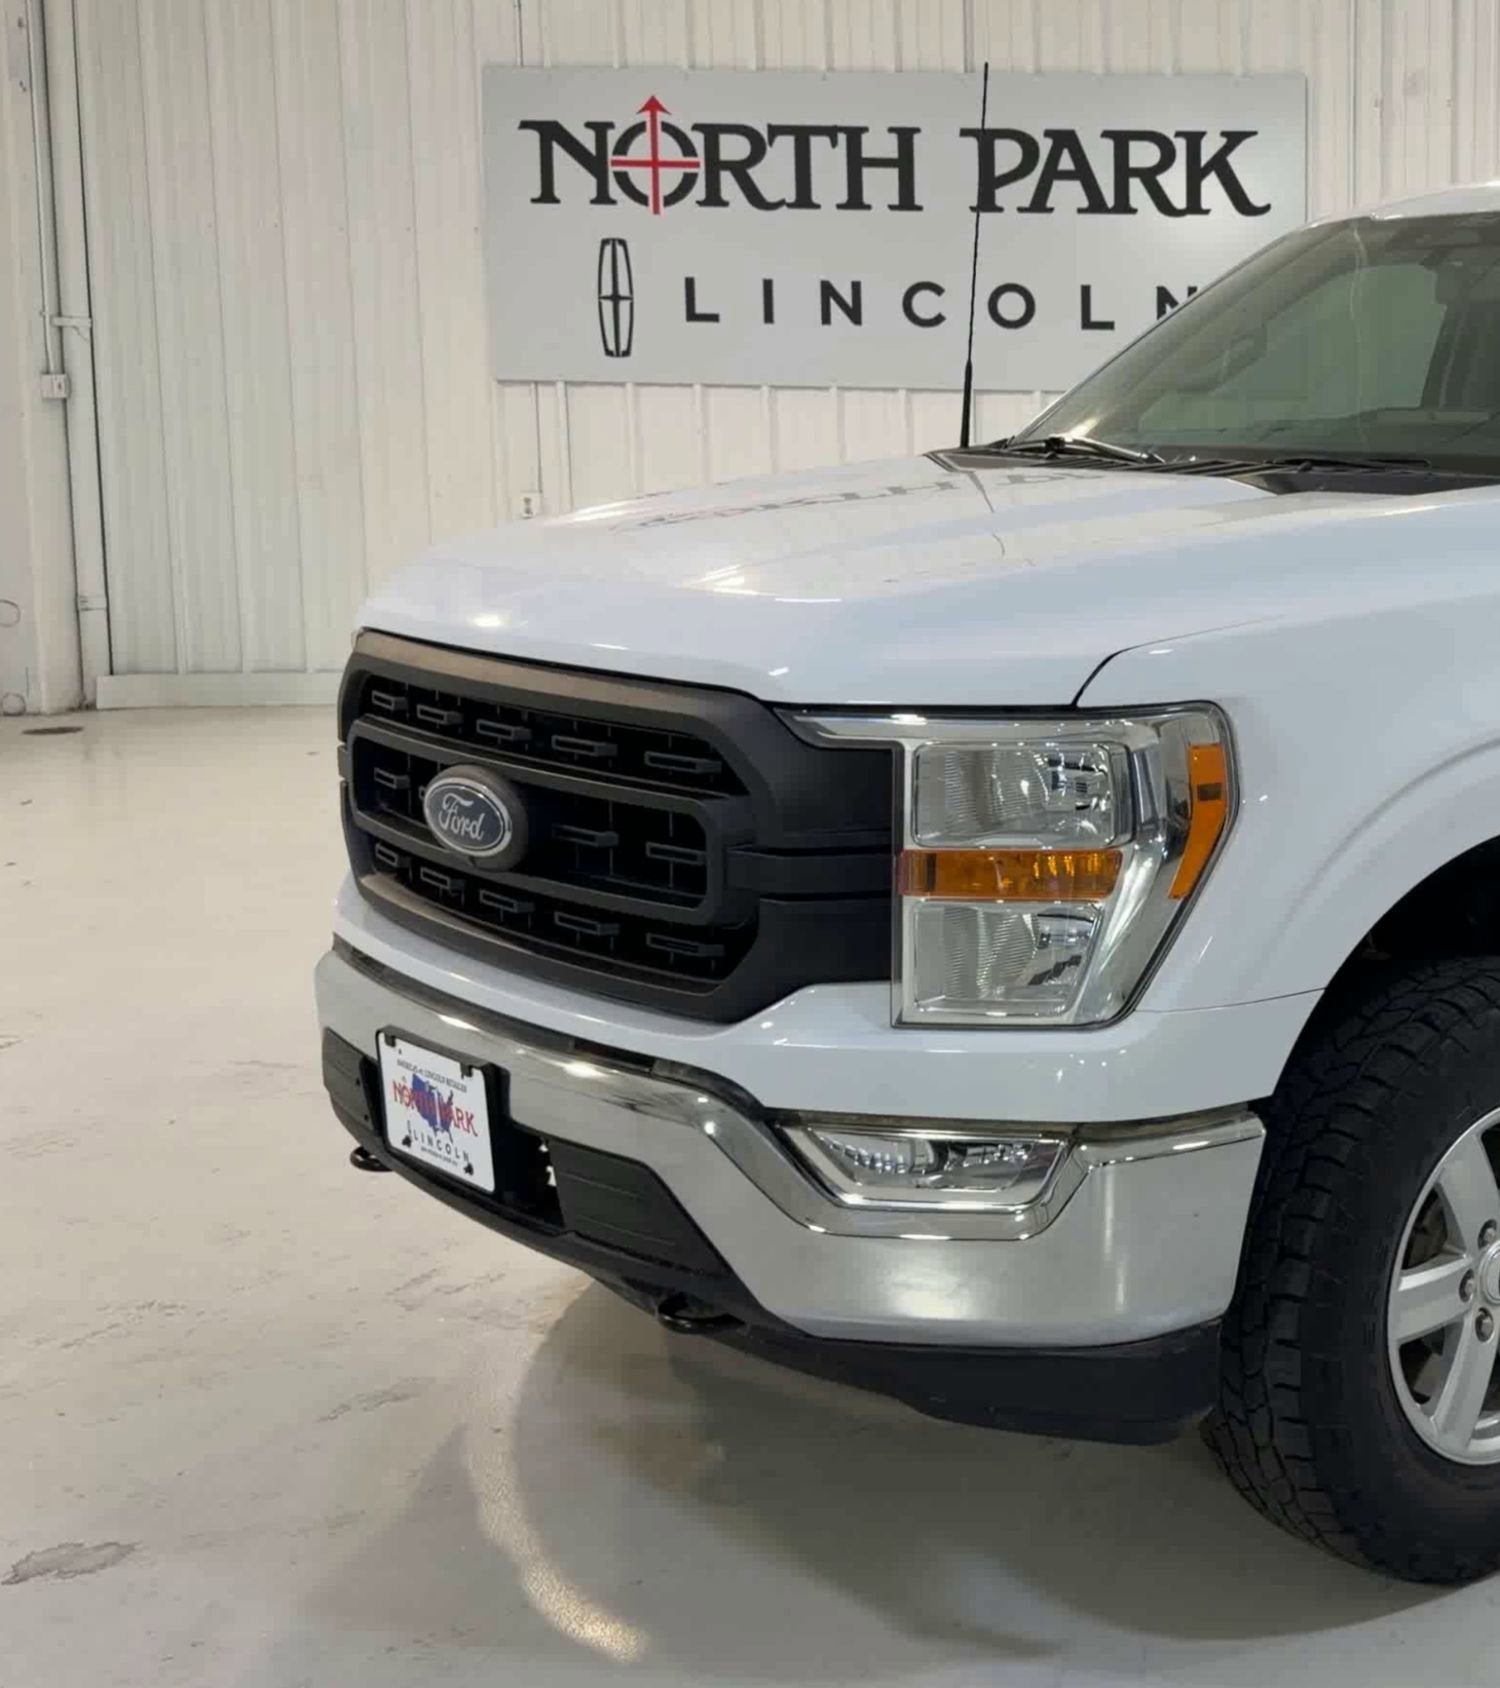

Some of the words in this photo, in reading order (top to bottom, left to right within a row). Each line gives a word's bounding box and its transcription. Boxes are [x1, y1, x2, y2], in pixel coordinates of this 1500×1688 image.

[518, 96, 923, 214] NORTH
[958, 128, 1271, 218] PARK
[438, 792, 486, 840] Ford
[413, 1129, 469, 1162] LINCOLN
